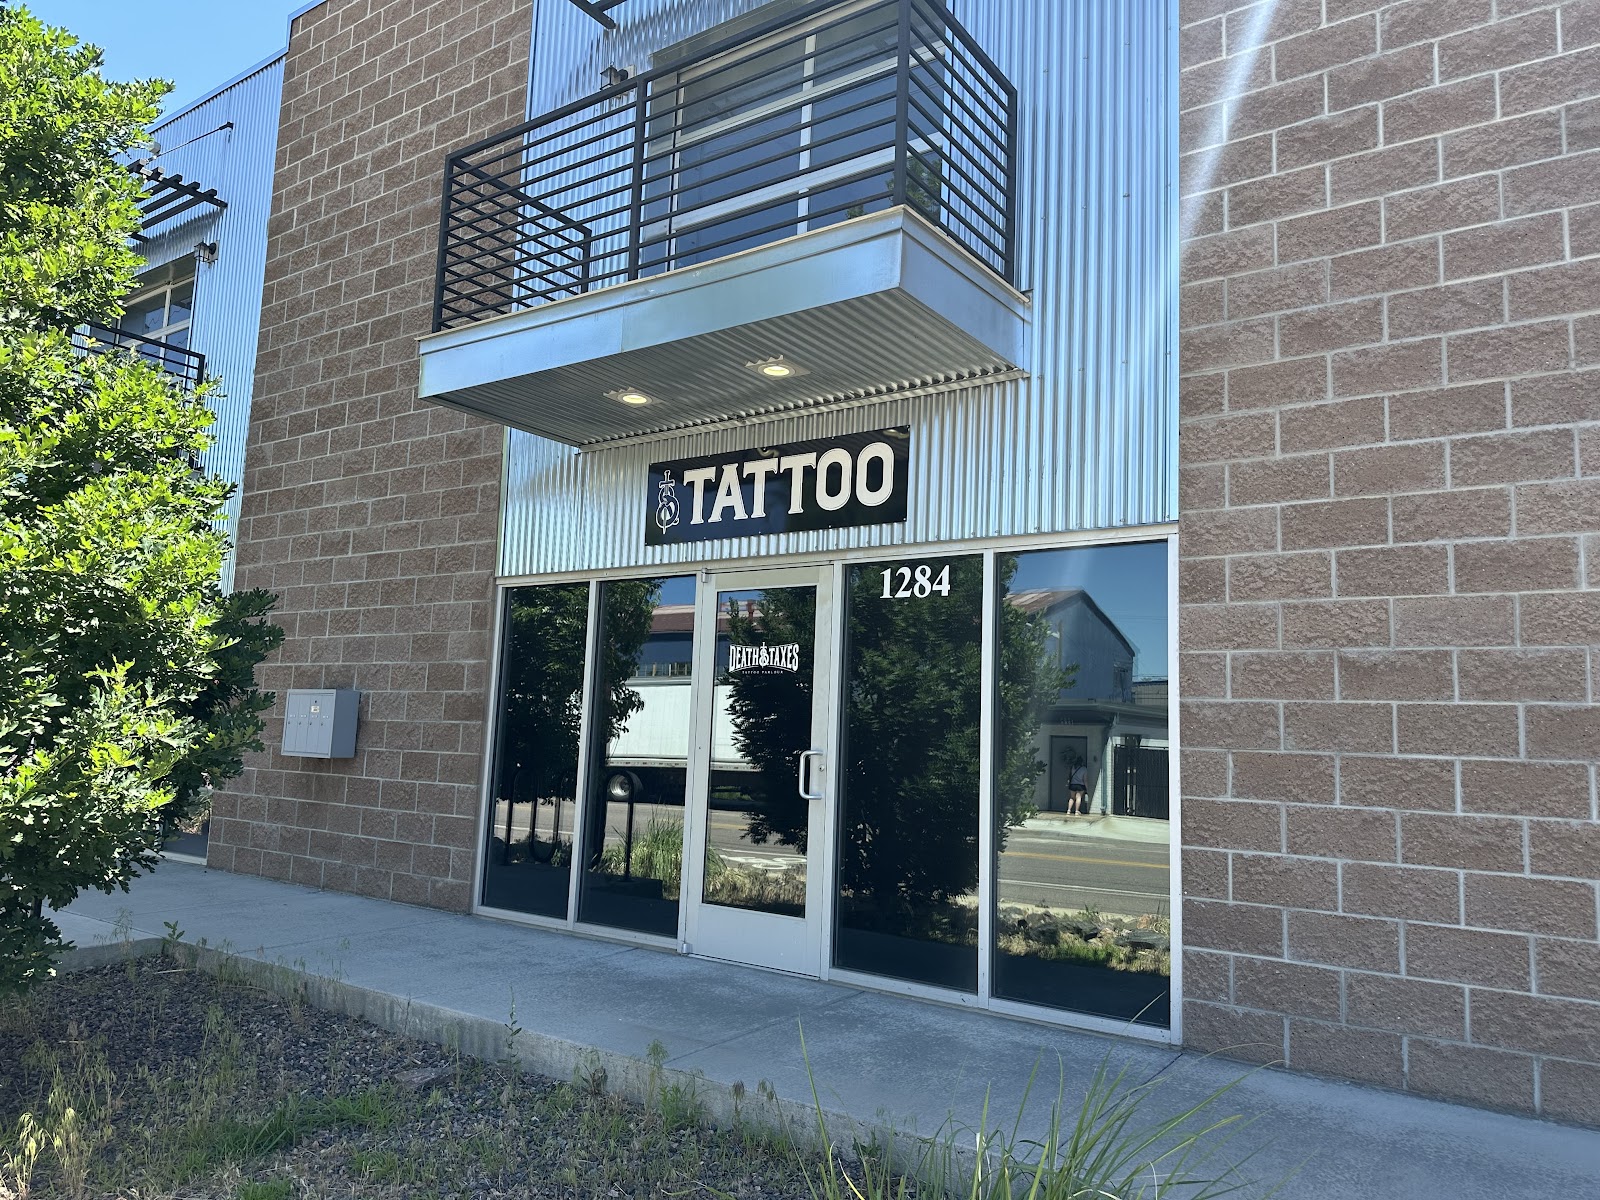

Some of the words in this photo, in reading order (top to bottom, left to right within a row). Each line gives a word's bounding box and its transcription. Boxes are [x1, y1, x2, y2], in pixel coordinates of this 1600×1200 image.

[683, 441, 895, 525] TATTOO
[879, 564, 951, 599] 1284
[729, 644, 759, 672] DEATH
[769, 643, 799, 672] TAXES
